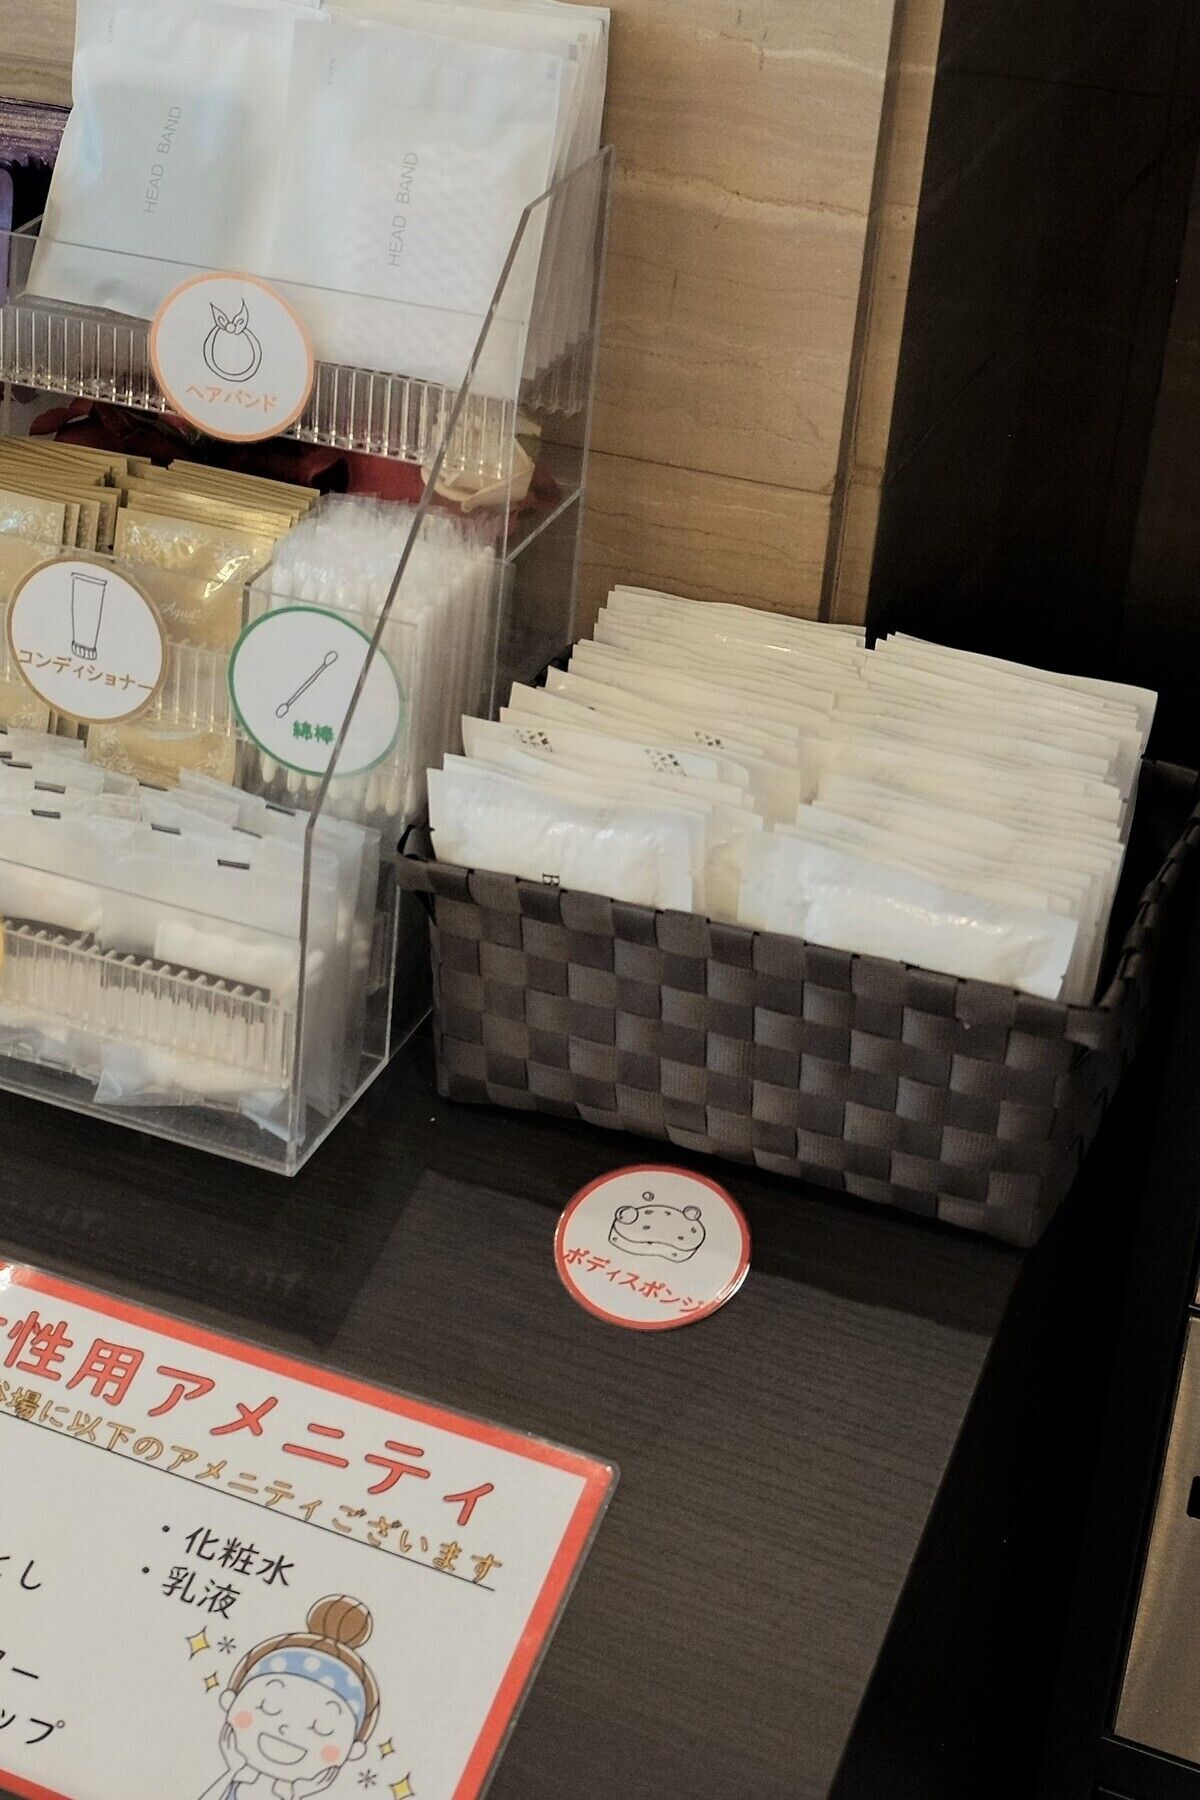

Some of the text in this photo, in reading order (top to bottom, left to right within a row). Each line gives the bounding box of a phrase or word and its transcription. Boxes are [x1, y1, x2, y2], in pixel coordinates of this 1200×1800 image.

[143, 105, 182, 214] HEAD BAND
[387, 152, 418, 267] HEAD BAND
[18, 649, 154, 690] コンディショナー
[563, 1247, 704, 1313] ボディスポンジ
[185, 1526, 294, 1586] 化粧水
[162, 1565, 241, 1620] 乳液
